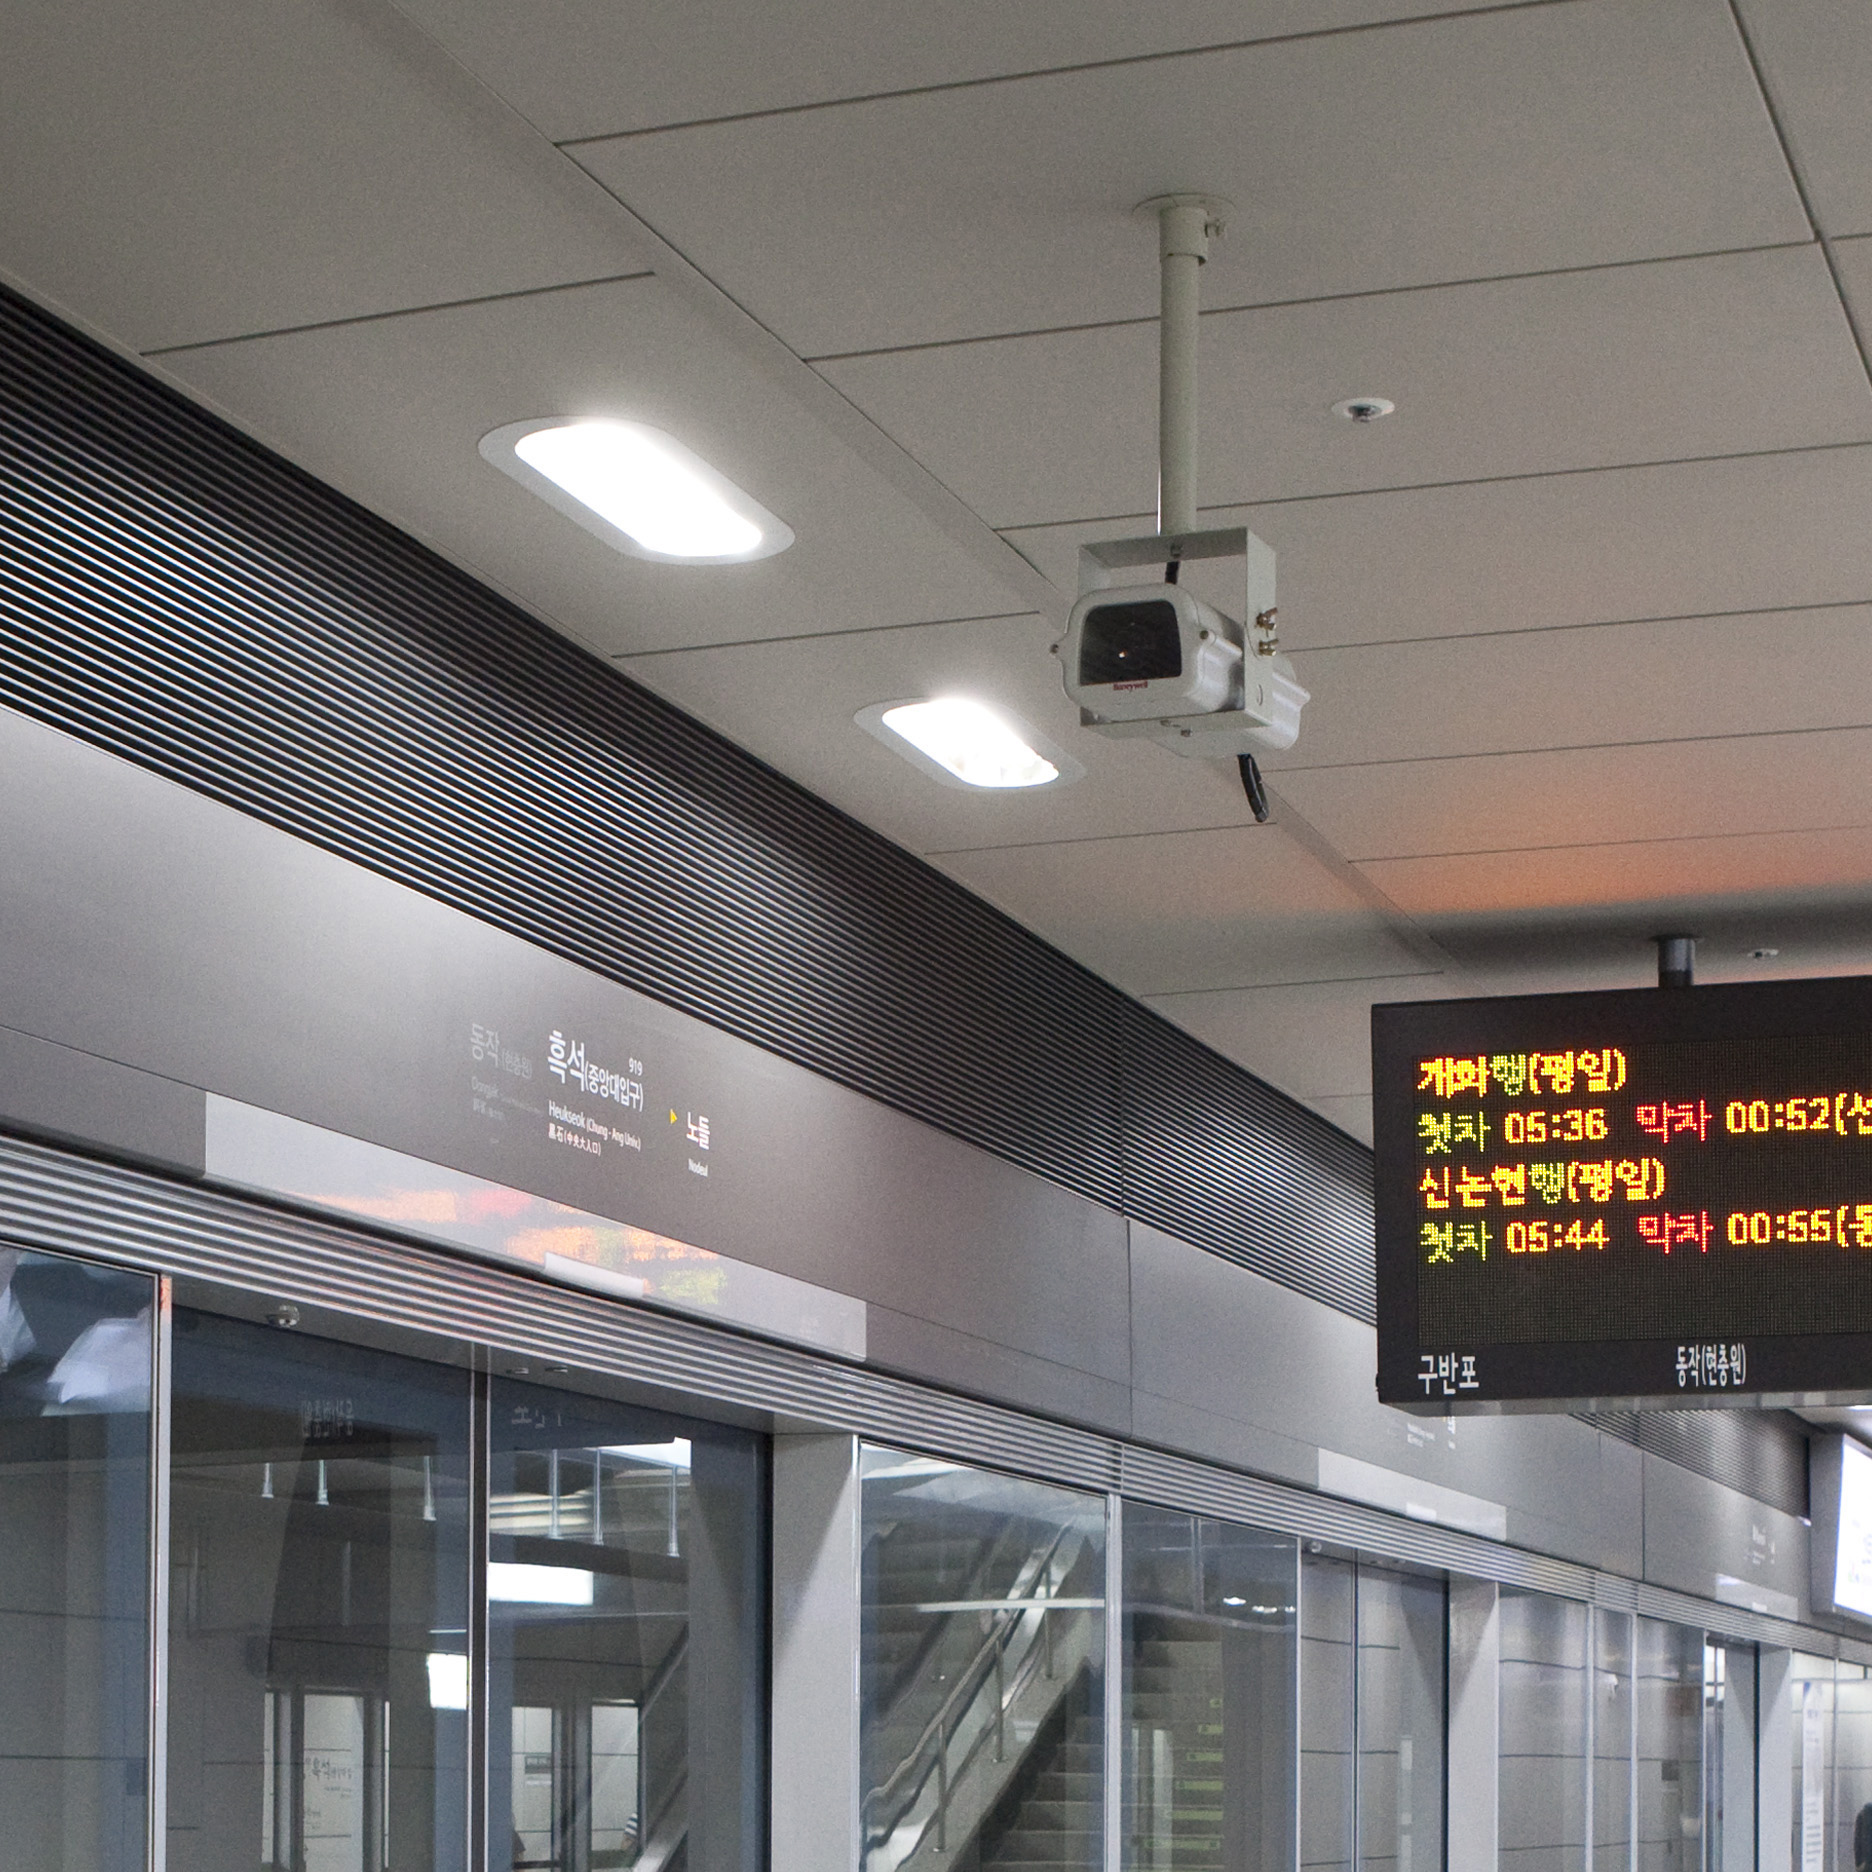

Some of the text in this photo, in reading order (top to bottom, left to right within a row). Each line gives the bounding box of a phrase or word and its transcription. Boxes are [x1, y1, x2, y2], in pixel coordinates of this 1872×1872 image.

[629, 1057, 643, 1076] 919
[1417, 1048, 1627, 1099] 개화행(평일)
[548, 1100, 586, 1129] Heukseok
[685, 1110, 711, 1151] 노들
[1418, 1110, 1492, 1155] 첫차
[1504, 1107, 1609, 1144] 05:36
[1635, 1099, 1713, 1144] 막차
[1419, 1157, 1666, 1209] 신논현행(평일)
[1420, 1220, 1494, 1264] 첫차
[1507, 1218, 1611, 1254] 05:44
[1638, 1210, 1714, 1255] 막차
[1417, 1354, 1480, 1395] 구반포
[1674, 1343, 1747, 1388] 동작(현충원)
